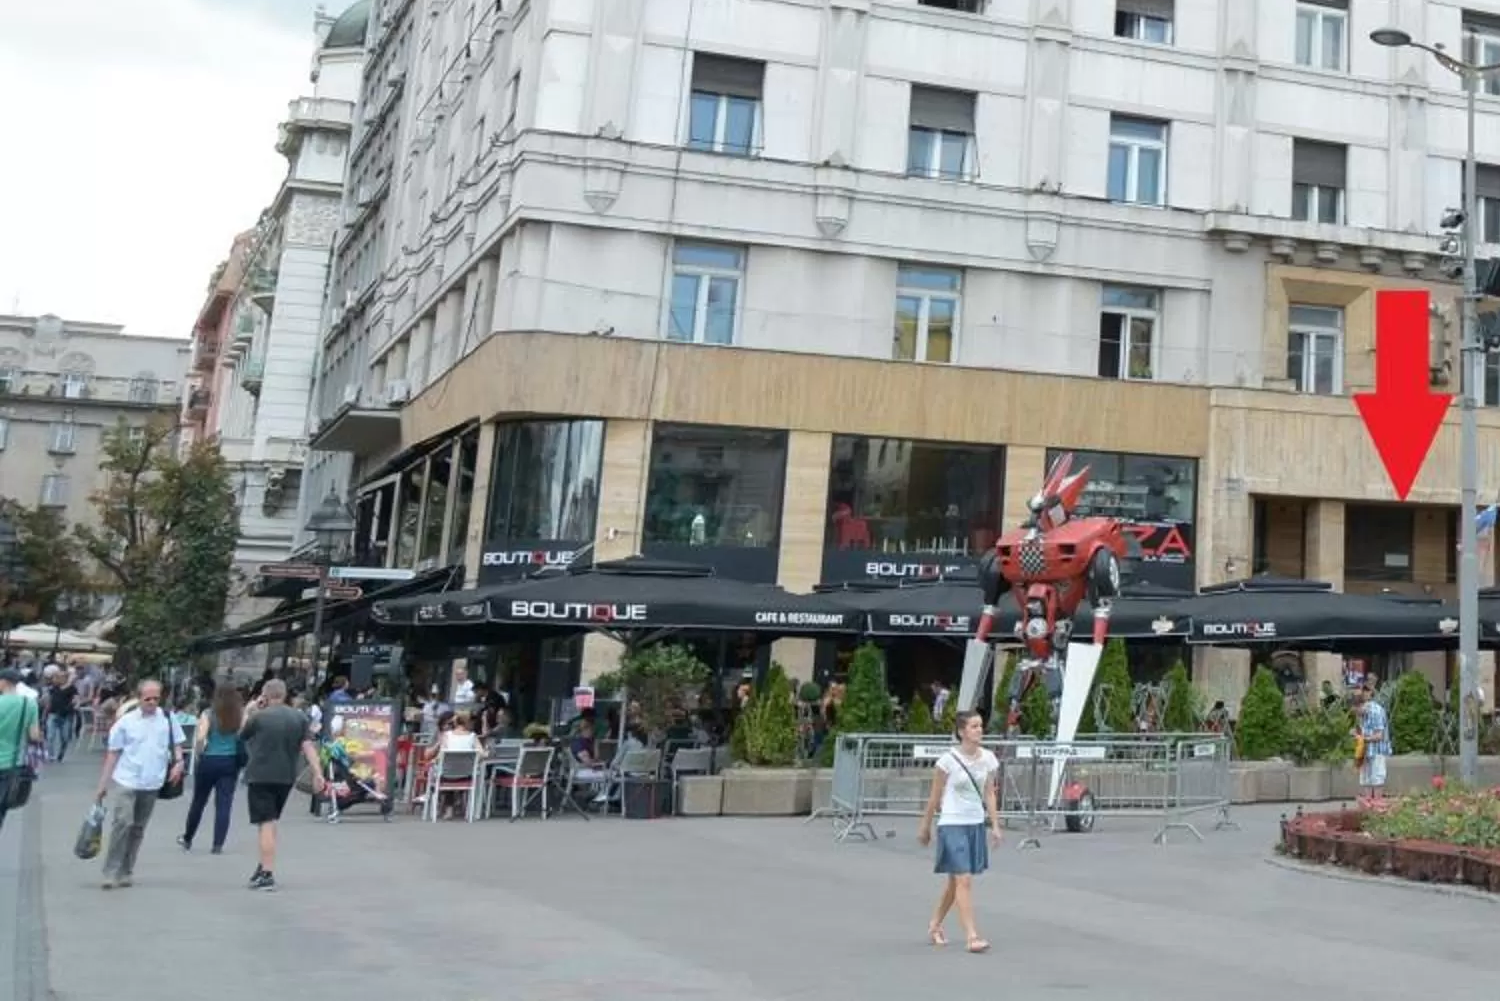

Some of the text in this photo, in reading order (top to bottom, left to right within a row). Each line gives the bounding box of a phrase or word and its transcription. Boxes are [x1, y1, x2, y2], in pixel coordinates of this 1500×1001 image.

[483, 550, 574, 566] BOUTIQUE
[511, 601, 647, 623] BOUTIQUE
[889, 614, 970, 627] BOUTIQUE
[1203, 621, 1277, 636] BOUTIQUE
